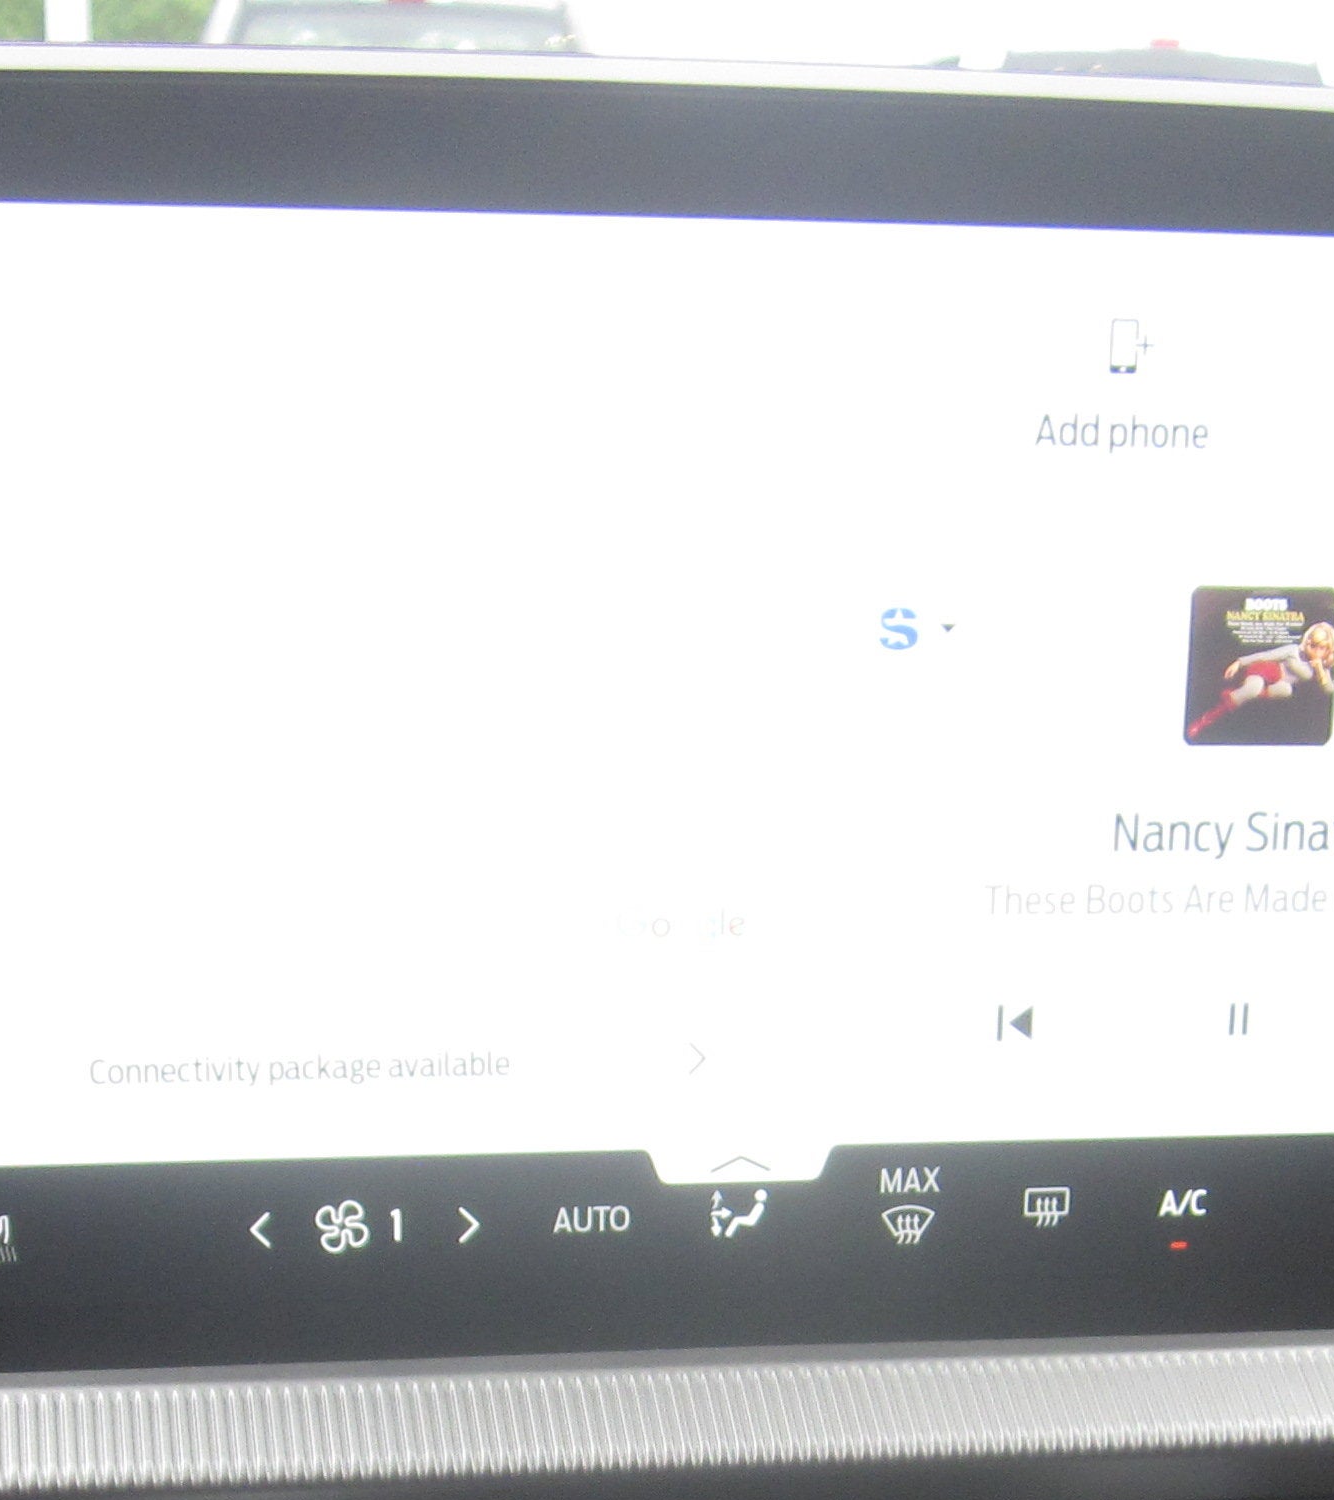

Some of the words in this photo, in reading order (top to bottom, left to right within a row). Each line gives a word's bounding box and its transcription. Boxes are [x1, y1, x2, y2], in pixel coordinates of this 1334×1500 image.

[1034, 412, 1100, 448] Add
[1108, 413, 1210, 455] phone
[1112, 811, 1234, 861] Nancy
[983, 882, 1076, 916] These
[1085, 882, 1174, 916] Boots
[1182, 882, 1235, 916] Are
[1243, 880, 1328, 914] Made
[89, 1053, 260, 1087] Connectivity
[268, 1051, 381, 1086] package
[388, 1049, 511, 1081] available
[879, 1166, 942, 1194] MAX
[553, 1204, 633, 1236] AUTO
[1158, 1188, 1209, 1219] A/C
[387, 1208, 404, 1243] 1
